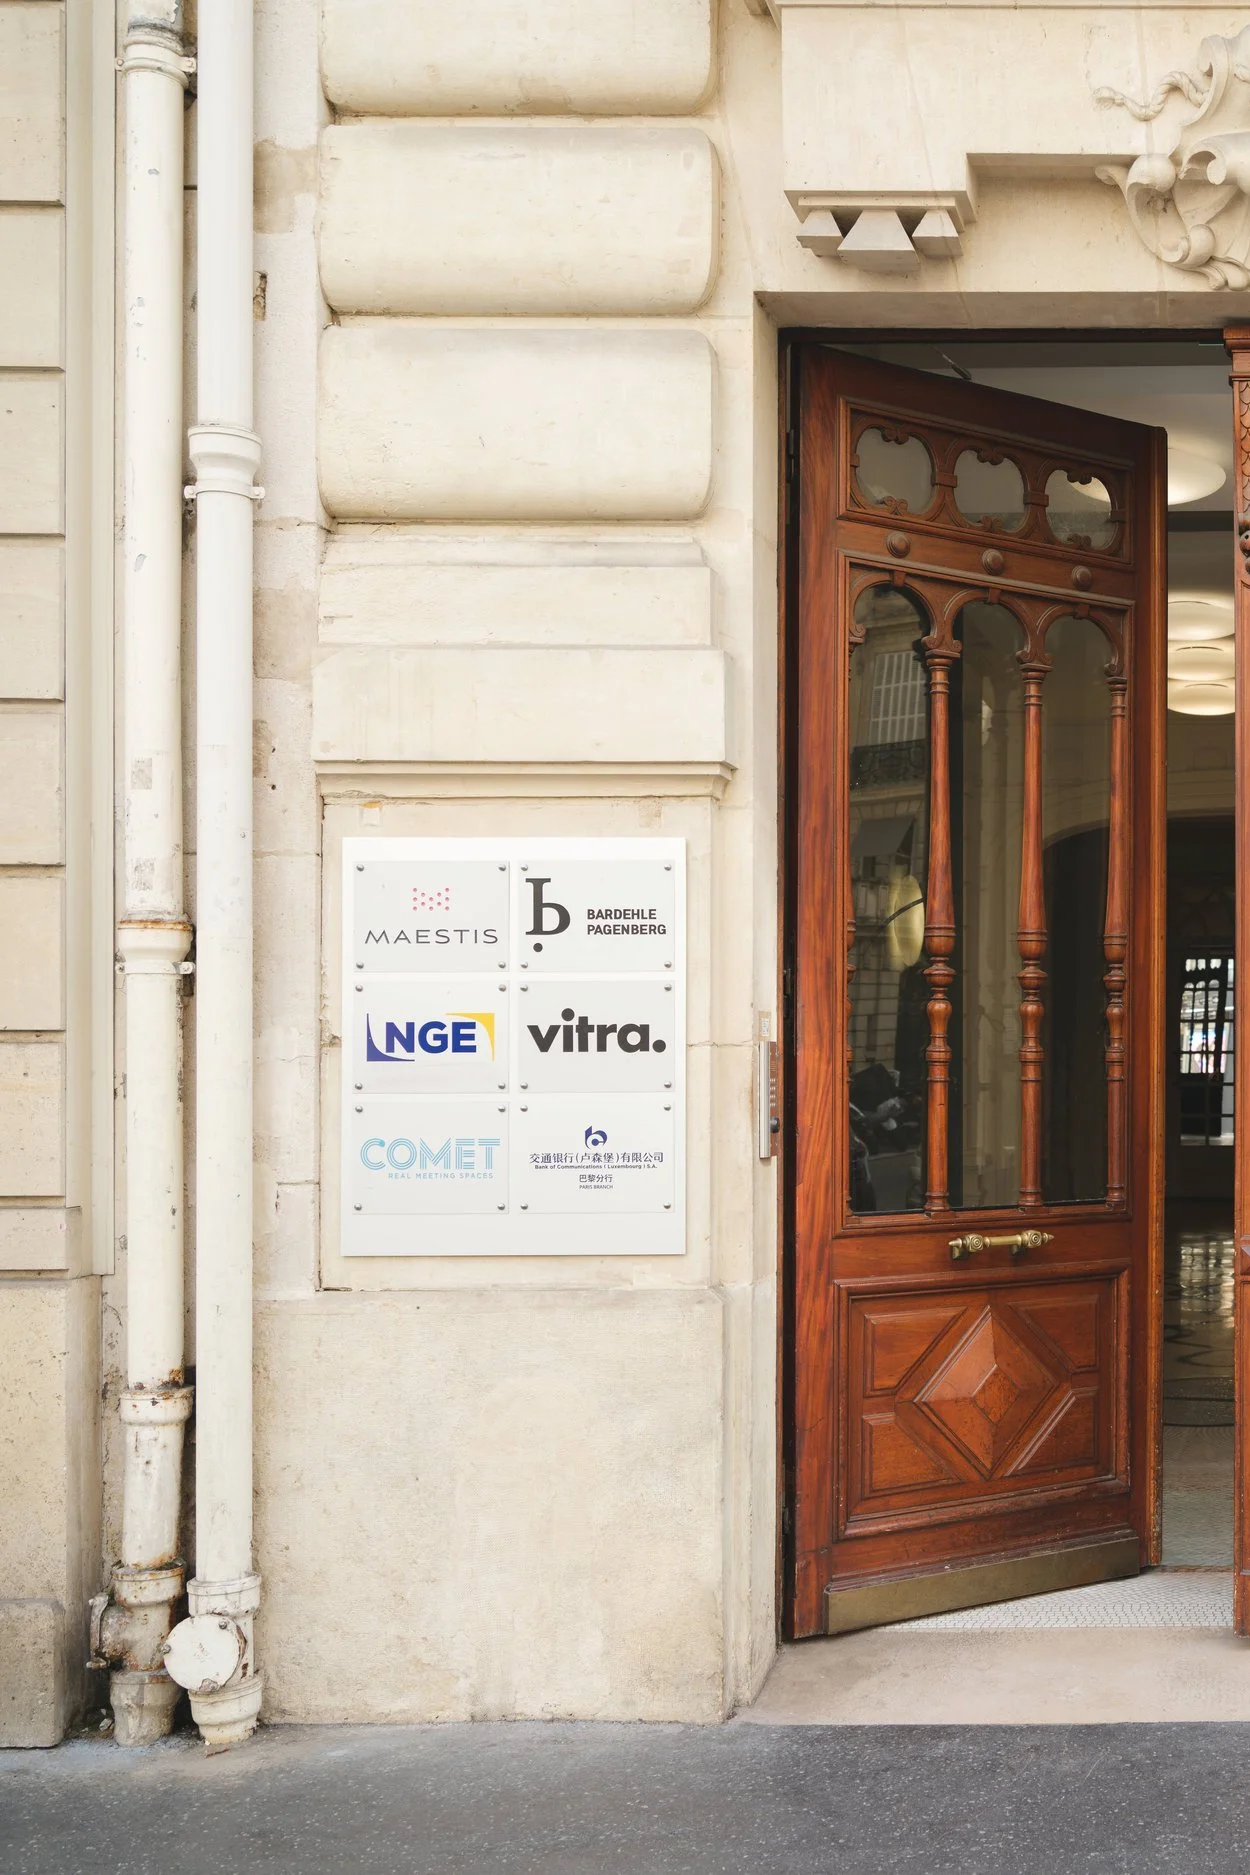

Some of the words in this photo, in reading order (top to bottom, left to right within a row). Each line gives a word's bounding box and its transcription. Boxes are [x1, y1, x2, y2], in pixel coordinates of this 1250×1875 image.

[587, 908, 657, 920] BARDEHLE
[587, 924, 667, 936] PAGENBERG
[365, 929, 499, 945] MAESTIS
[385, 1021, 477, 1054] NGE
[360, 1137, 501, 1171] COMET
[388, 1172, 411, 1180] REAL
[415, 1172, 457, 1180] MEETING
[459, 1172, 494, 1180] SPACES
[579, 1173, 613, 1183] 巴黎分行
